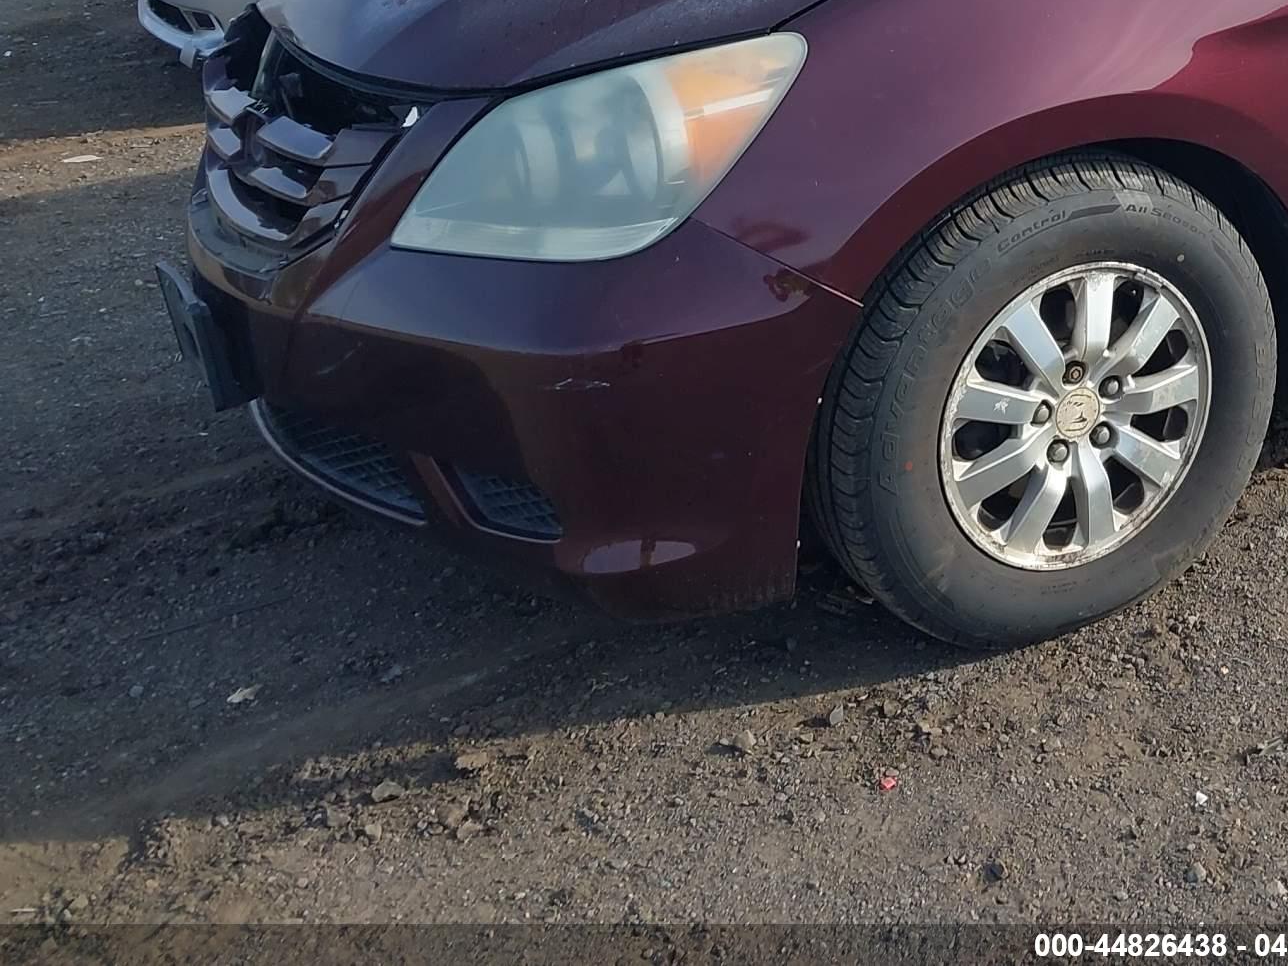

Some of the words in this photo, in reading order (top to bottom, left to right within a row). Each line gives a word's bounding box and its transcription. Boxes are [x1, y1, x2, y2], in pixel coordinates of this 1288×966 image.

[997, 210, 1067, 253] Control
[1125, 203, 1148, 213] All
[1150, 207, 1207, 238] Season
